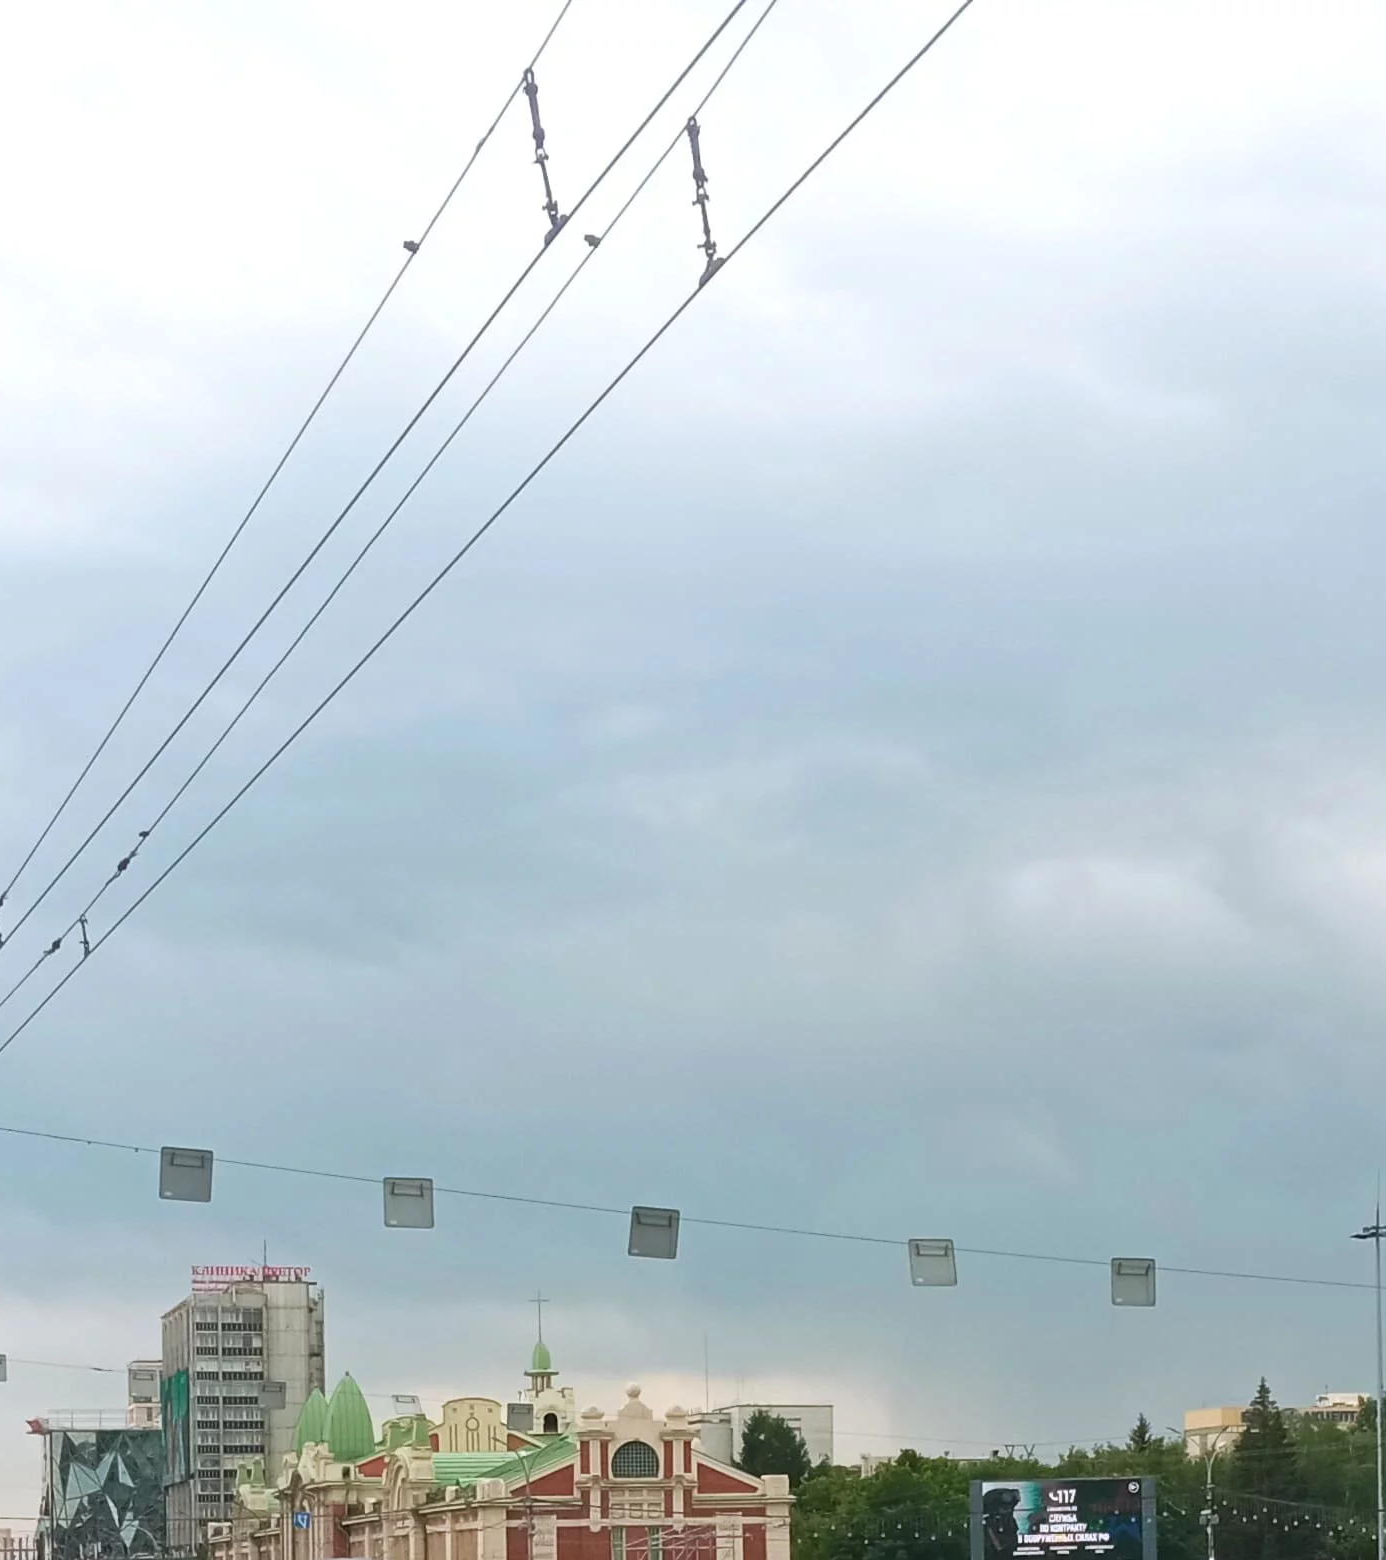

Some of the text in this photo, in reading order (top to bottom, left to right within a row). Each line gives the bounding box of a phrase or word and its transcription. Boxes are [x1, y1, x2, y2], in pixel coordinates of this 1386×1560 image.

[191, 1265, 260, 1277] КЛИНИКА
[1057, 1489, 1077, 1504] 117
[1048, 1514, 1078, 1524] СЛУЖБА
[1098, 1533, 1110, 1543] РФ
